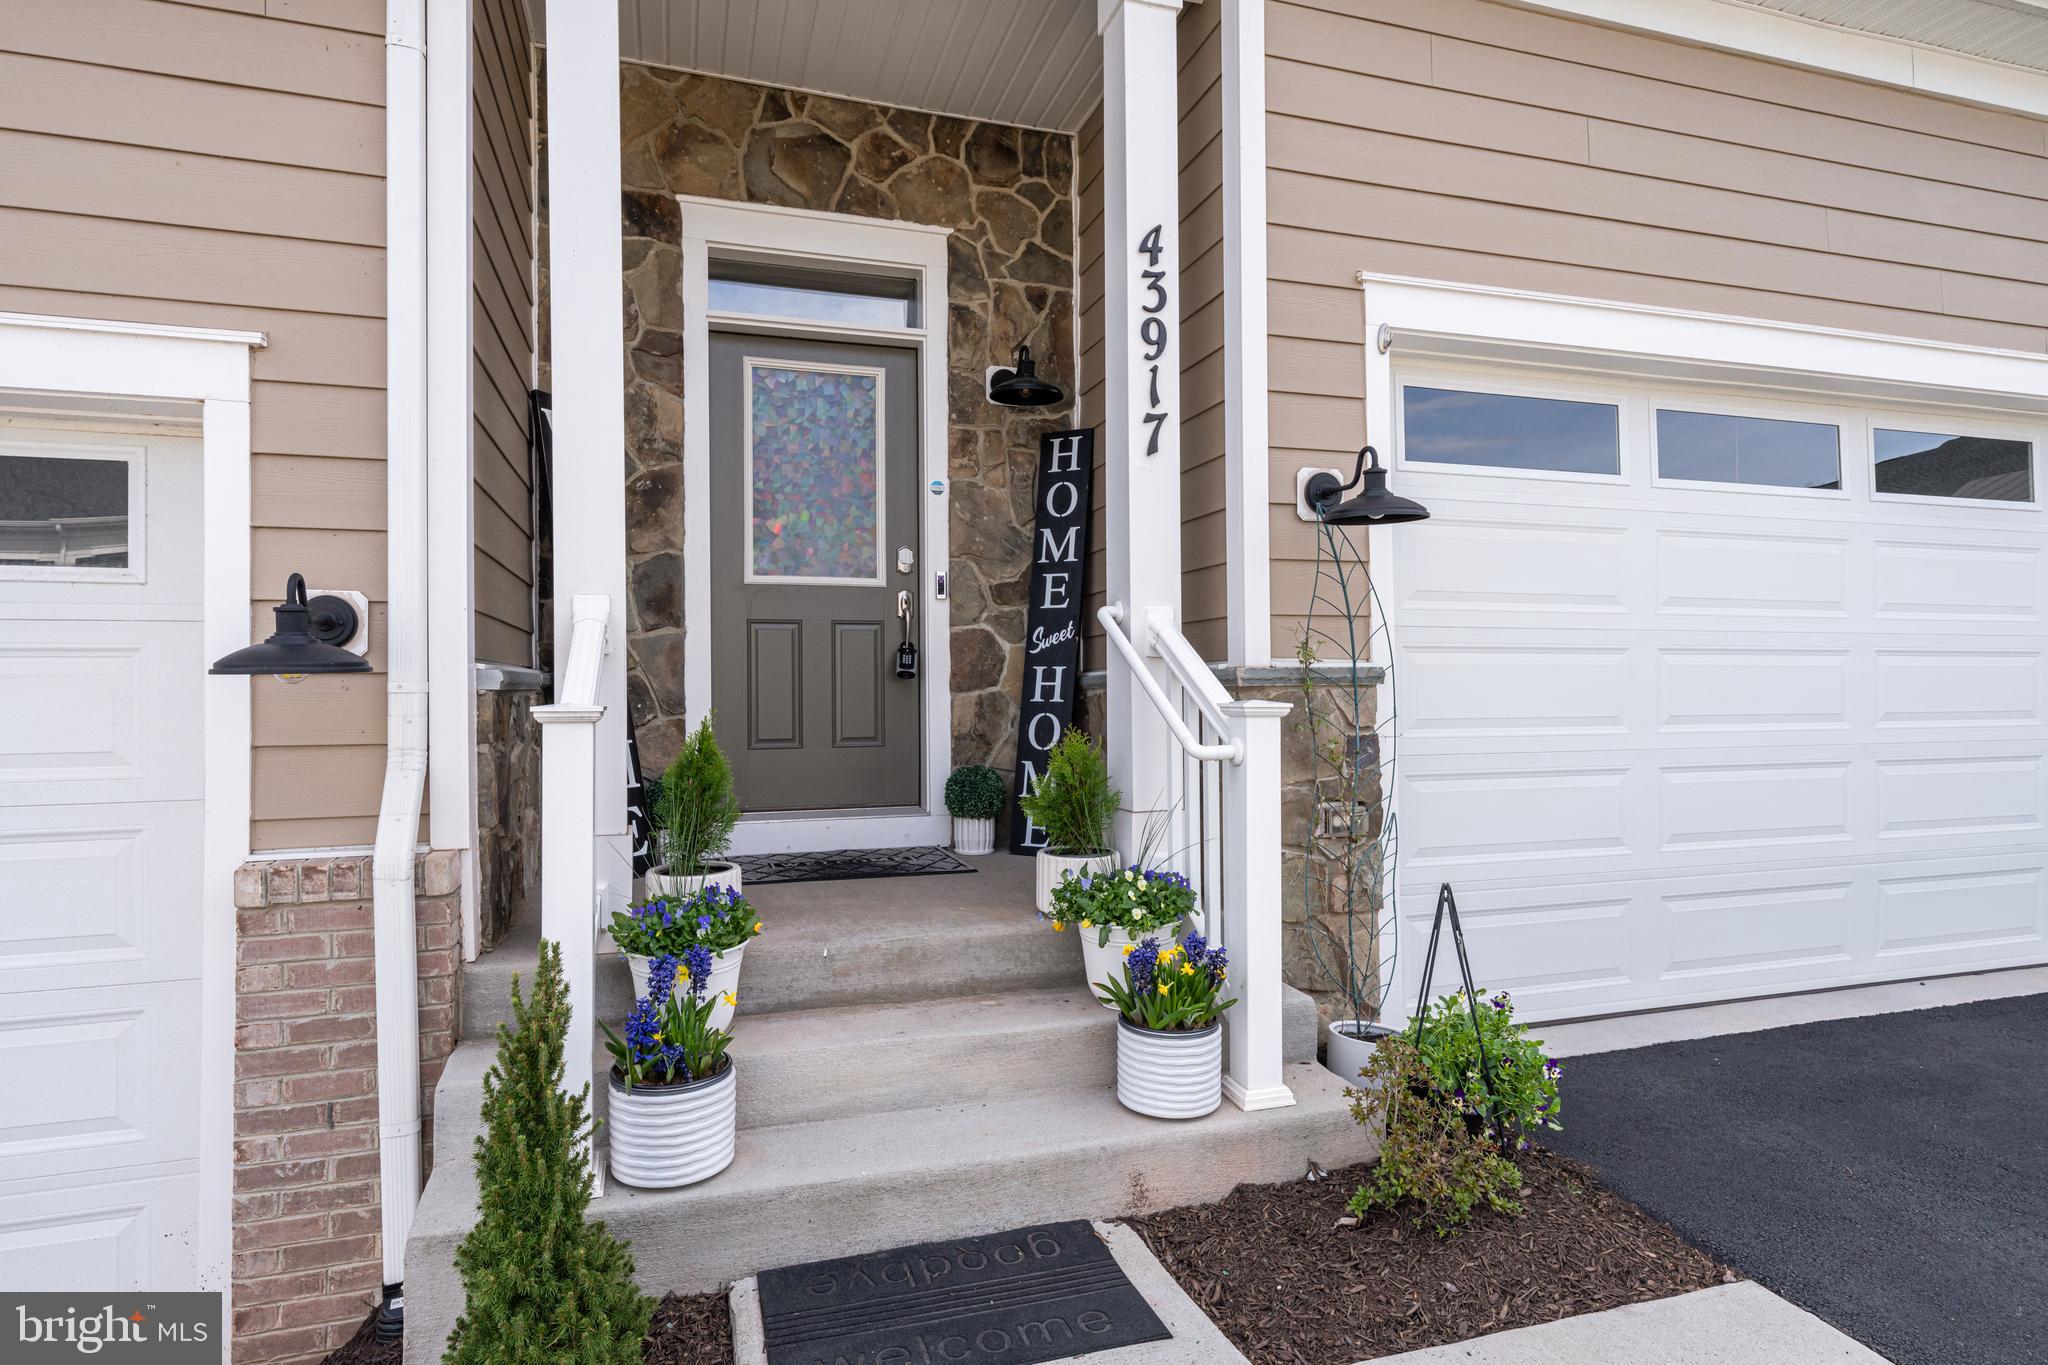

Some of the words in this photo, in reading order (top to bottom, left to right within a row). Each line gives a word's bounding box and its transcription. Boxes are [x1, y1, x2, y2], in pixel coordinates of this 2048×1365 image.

[1138, 224, 1168, 457] 43917
[1037, 435, 1083, 609] HOME
[1029, 620, 1075, 654] Sweet
[807, 1231, 1061, 1295] goodbye
